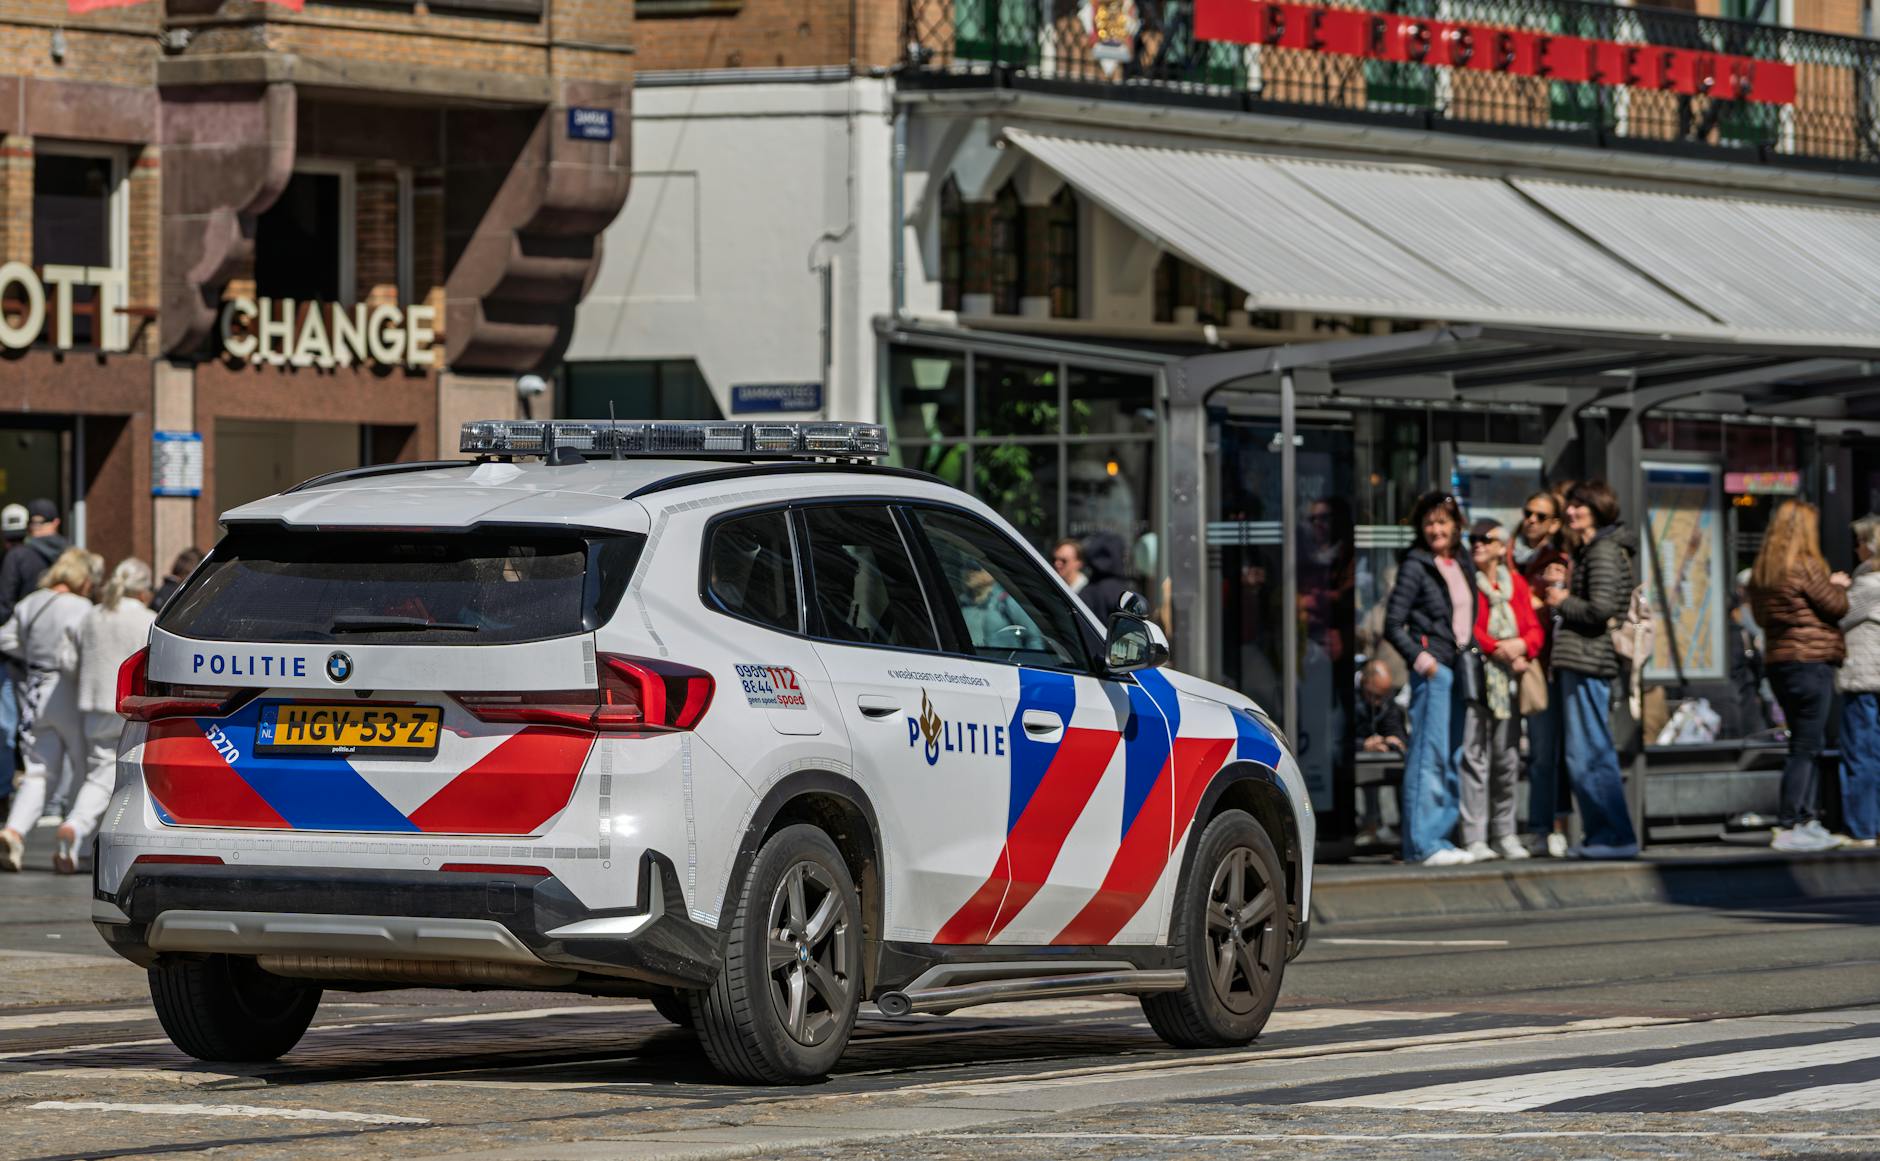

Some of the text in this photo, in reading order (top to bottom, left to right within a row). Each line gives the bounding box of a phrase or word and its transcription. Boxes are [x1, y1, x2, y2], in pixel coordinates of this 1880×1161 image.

[1262, 4, 1326, 50] DE
[1364, 16, 1552, 78] ROODE
[221, 297, 436, 366] CHANGE
[193, 654, 306, 677] POLITIE
[767, 666, 800, 690] 112
[777, 692, 806, 709] spoed
[261, 729, 273, 739] NL
[286, 710, 429, 743] HGV-53-Z
[907, 715, 1005, 766] POLITIE
[205, 723, 240, 764] 5270
